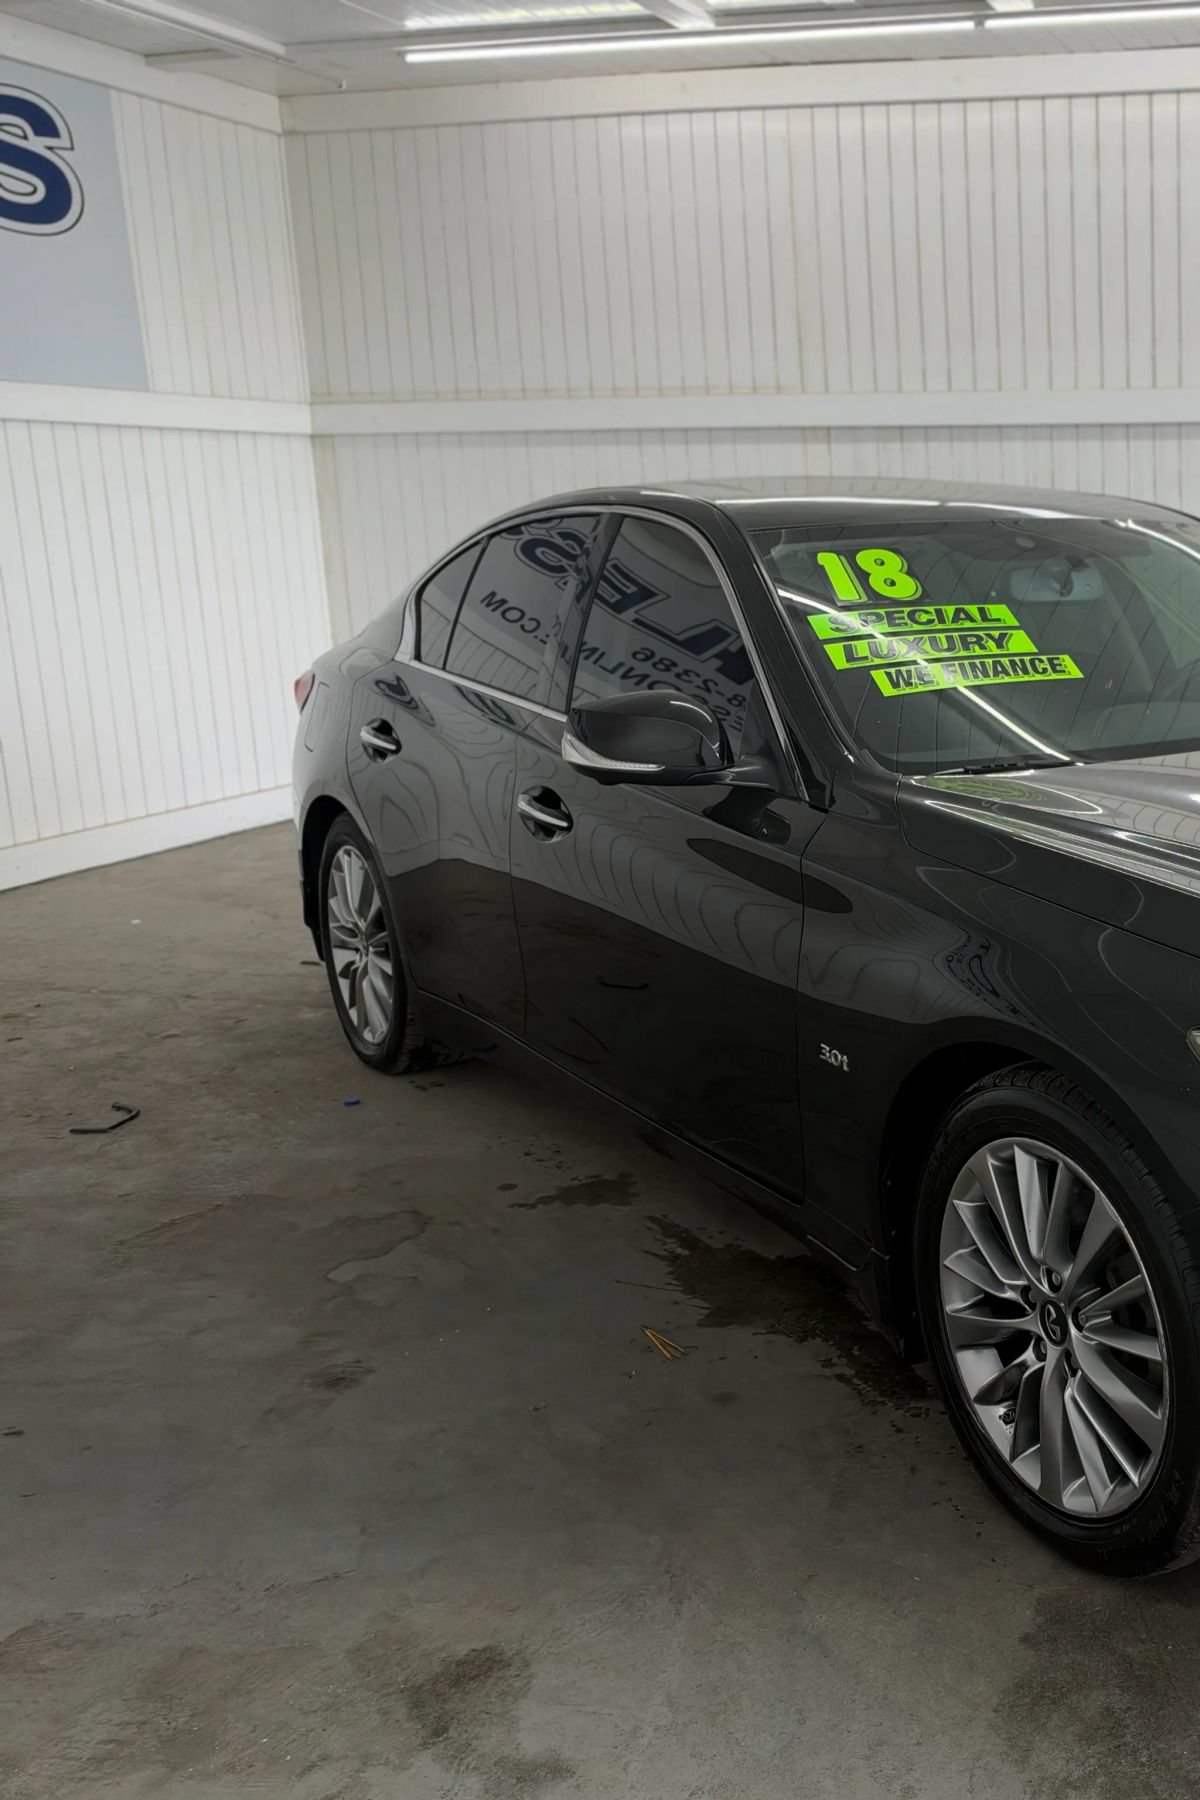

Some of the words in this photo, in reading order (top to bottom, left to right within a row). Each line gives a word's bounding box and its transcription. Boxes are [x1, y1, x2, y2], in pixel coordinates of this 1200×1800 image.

[817, 549, 922, 602] 18
[829, 606, 1005, 633] SPECIAL
[843, 632, 1012, 664] LUXURY
[884, 666, 937, 691] WE
[943, 656, 1071, 682] FINANCE
